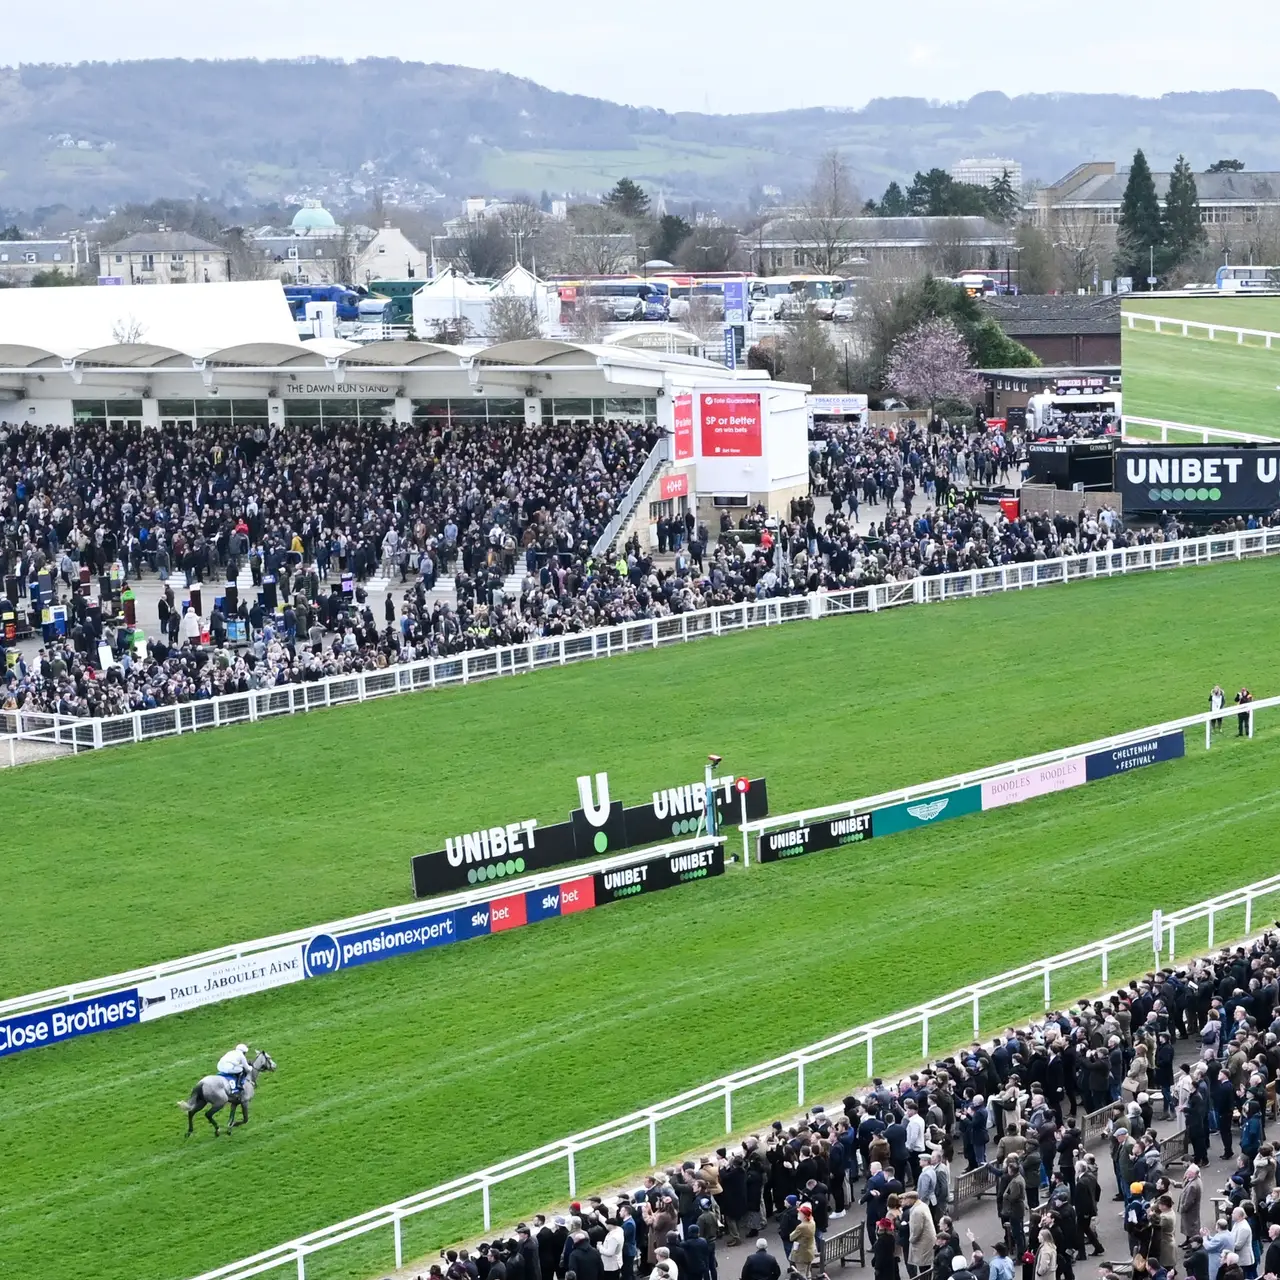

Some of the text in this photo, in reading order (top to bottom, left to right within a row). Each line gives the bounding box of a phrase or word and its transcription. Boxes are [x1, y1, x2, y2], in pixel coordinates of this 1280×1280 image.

[287, 384, 389, 393] THE DAWN RUN STAND
[705, 416, 716, 425] SP
[729, 416, 756, 425] Better
[1126, 458, 1243, 485] UNIBET
[666, 481, 683, 493] tote
[1112, 741, 1159, 761] CHELTENHAM
[1120, 755, 1152, 770] FESTIVAL
[991, 763, 1078, 795] BOODLES BOODLES
[576, 771, 611, 829] U
[445, 818, 539, 868] UNIBET
[769, 814, 871, 851] UNIBET UNIBET
[604, 849, 714, 891] UNIBET UNIBET
[542, 887, 580, 909] sky bet
[471, 905, 510, 928] sky bet
[310, 918, 453, 968] my pensionexpert
[212, 960, 257, 977] DOMAINES
[169, 985, 202, 1001] PAUL
[203, 967, 266, 993] JABOULET
[52, 996, 137, 1038] Brothers
[229, 1080, 236, 1090] 9
